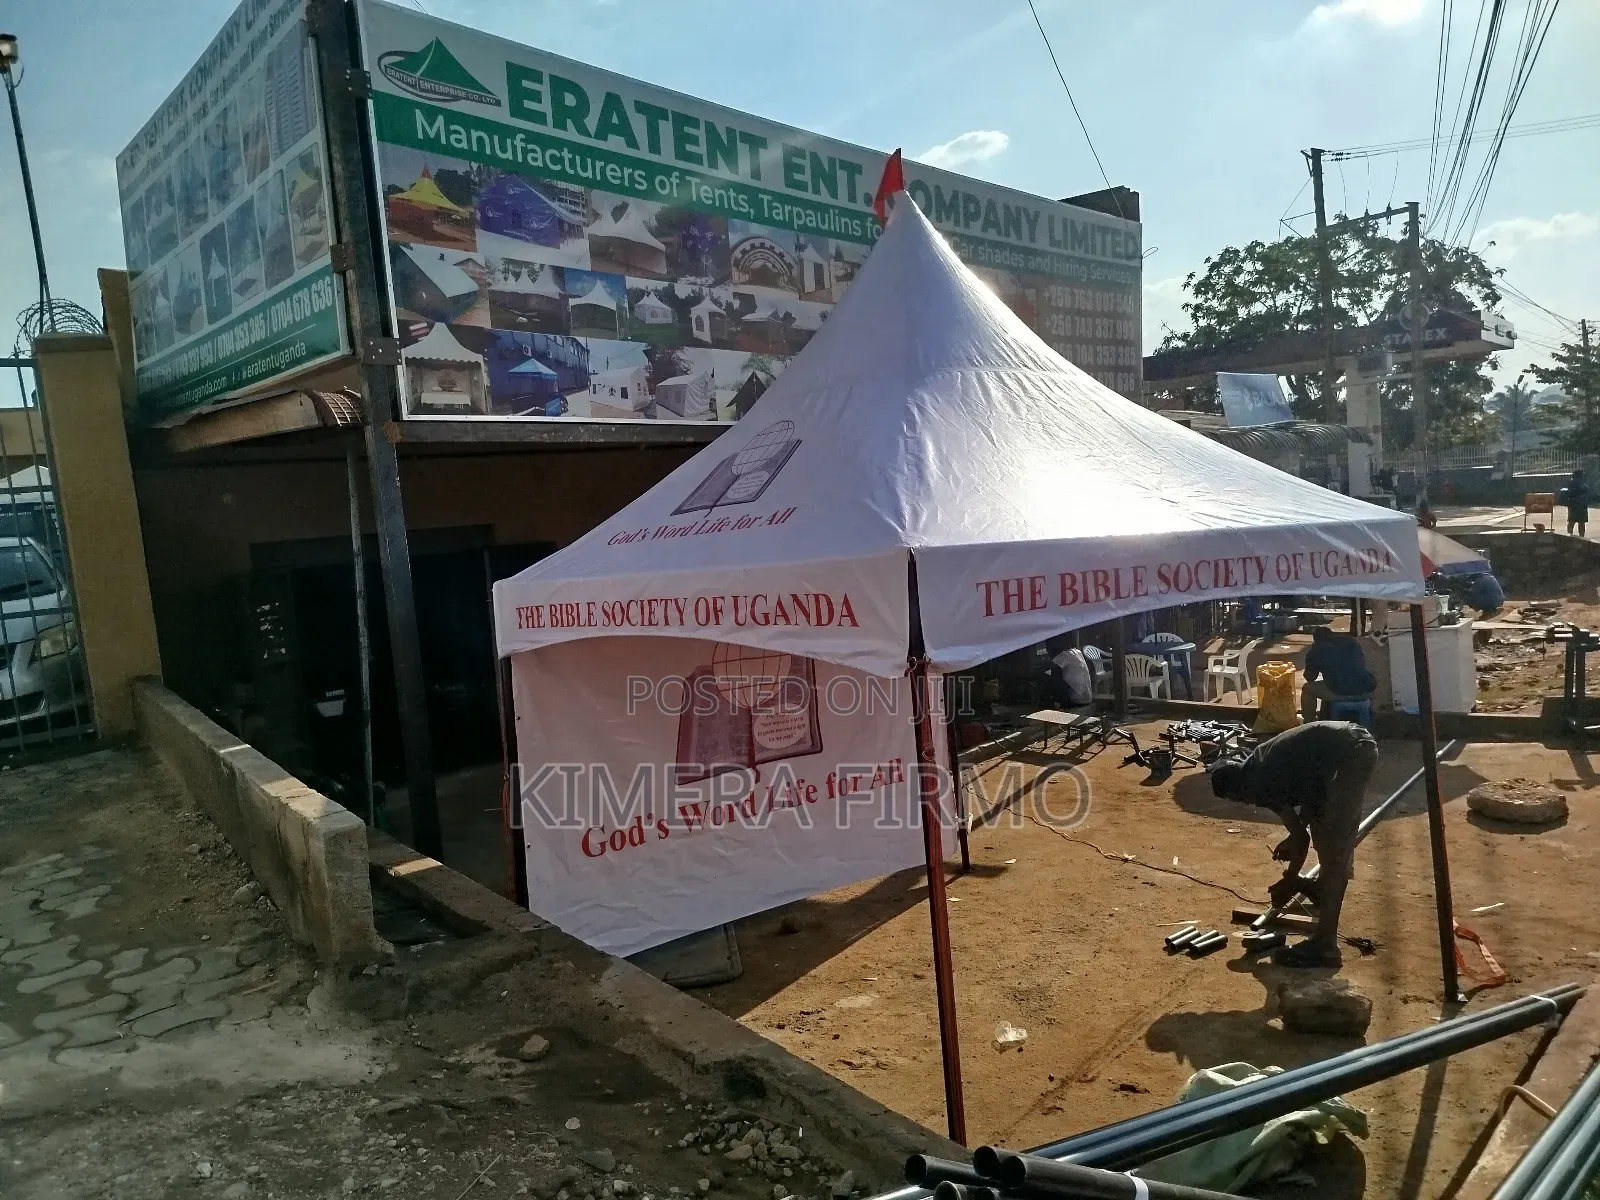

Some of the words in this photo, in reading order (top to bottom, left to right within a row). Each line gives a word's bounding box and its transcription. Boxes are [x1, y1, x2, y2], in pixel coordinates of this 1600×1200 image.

[387, 68, 416, 86] ERATENT
[420, 81, 467, 98] ENTERPRISE
[505, 61, 767, 180] ERATENT
[782, 145, 874, 207] ENT.
[887, 179, 1041, 244] OMPANY
[1050, 216, 1140, 262] LIMITED
[414, 108, 647, 191] Manufacturers
[655, 171, 681, 199] of
[687, 178, 756, 216] Tents,
[762, 192, 862, 237] Tarpaulins
[866, 218, 884, 241] fo
[951, 236, 975, 258] Car
[978, 240, 1024, 268] shades
[1028, 252, 1049, 272] and
[1054, 255, 1088, 282] Hiring
[234, 320, 250, 352] 353
[249, 311, 266, 345] 385
[271, 297, 293, 333] 0704
[292, 287, 312, 323] 678
[311, 275, 333, 313] 636
[1044, 285, 1071, 309] +256
[1044, 313, 1072, 337] +256
[1074, 316, 1093, 338] 743
[1095, 318, 1115, 339] 337
[1116, 320, 1135, 340] 993
[1383, 327, 1448, 346] STAEX
[247, 339, 307, 379] eratentuganda
[1096, 345, 1116, 365] 353
[1118, 346, 1136, 366] 385
[1117, 372, 1135, 392] 636
[607, 527, 651, 546] God's
[651, 520, 698, 541] Word
[694, 516, 731, 536] Life
[730, 513, 763, 531] for
[759, 506, 798, 527] All
[976, 574, 1048, 618] THE
[1057, 564, 1149, 608] BIBLE
[1156, 554, 1271, 596] SOCIETY
[1275, 551, 1306, 582] OF
[1308, 546, 1394, 580] UGANDA
[515, 604, 545, 630] THE
[549, 600, 598, 628] BIBLE
[602, 597, 689, 628] SOCIETY
[693, 595, 725, 628] OF
[731, 592, 861, 628] UGANDA
[581, 815, 670, 860] God's
[677, 793, 757, 836] Word
[765, 777, 820, 815] Life
[824, 770, 864, 801] for
[868, 755, 906, 791] All
